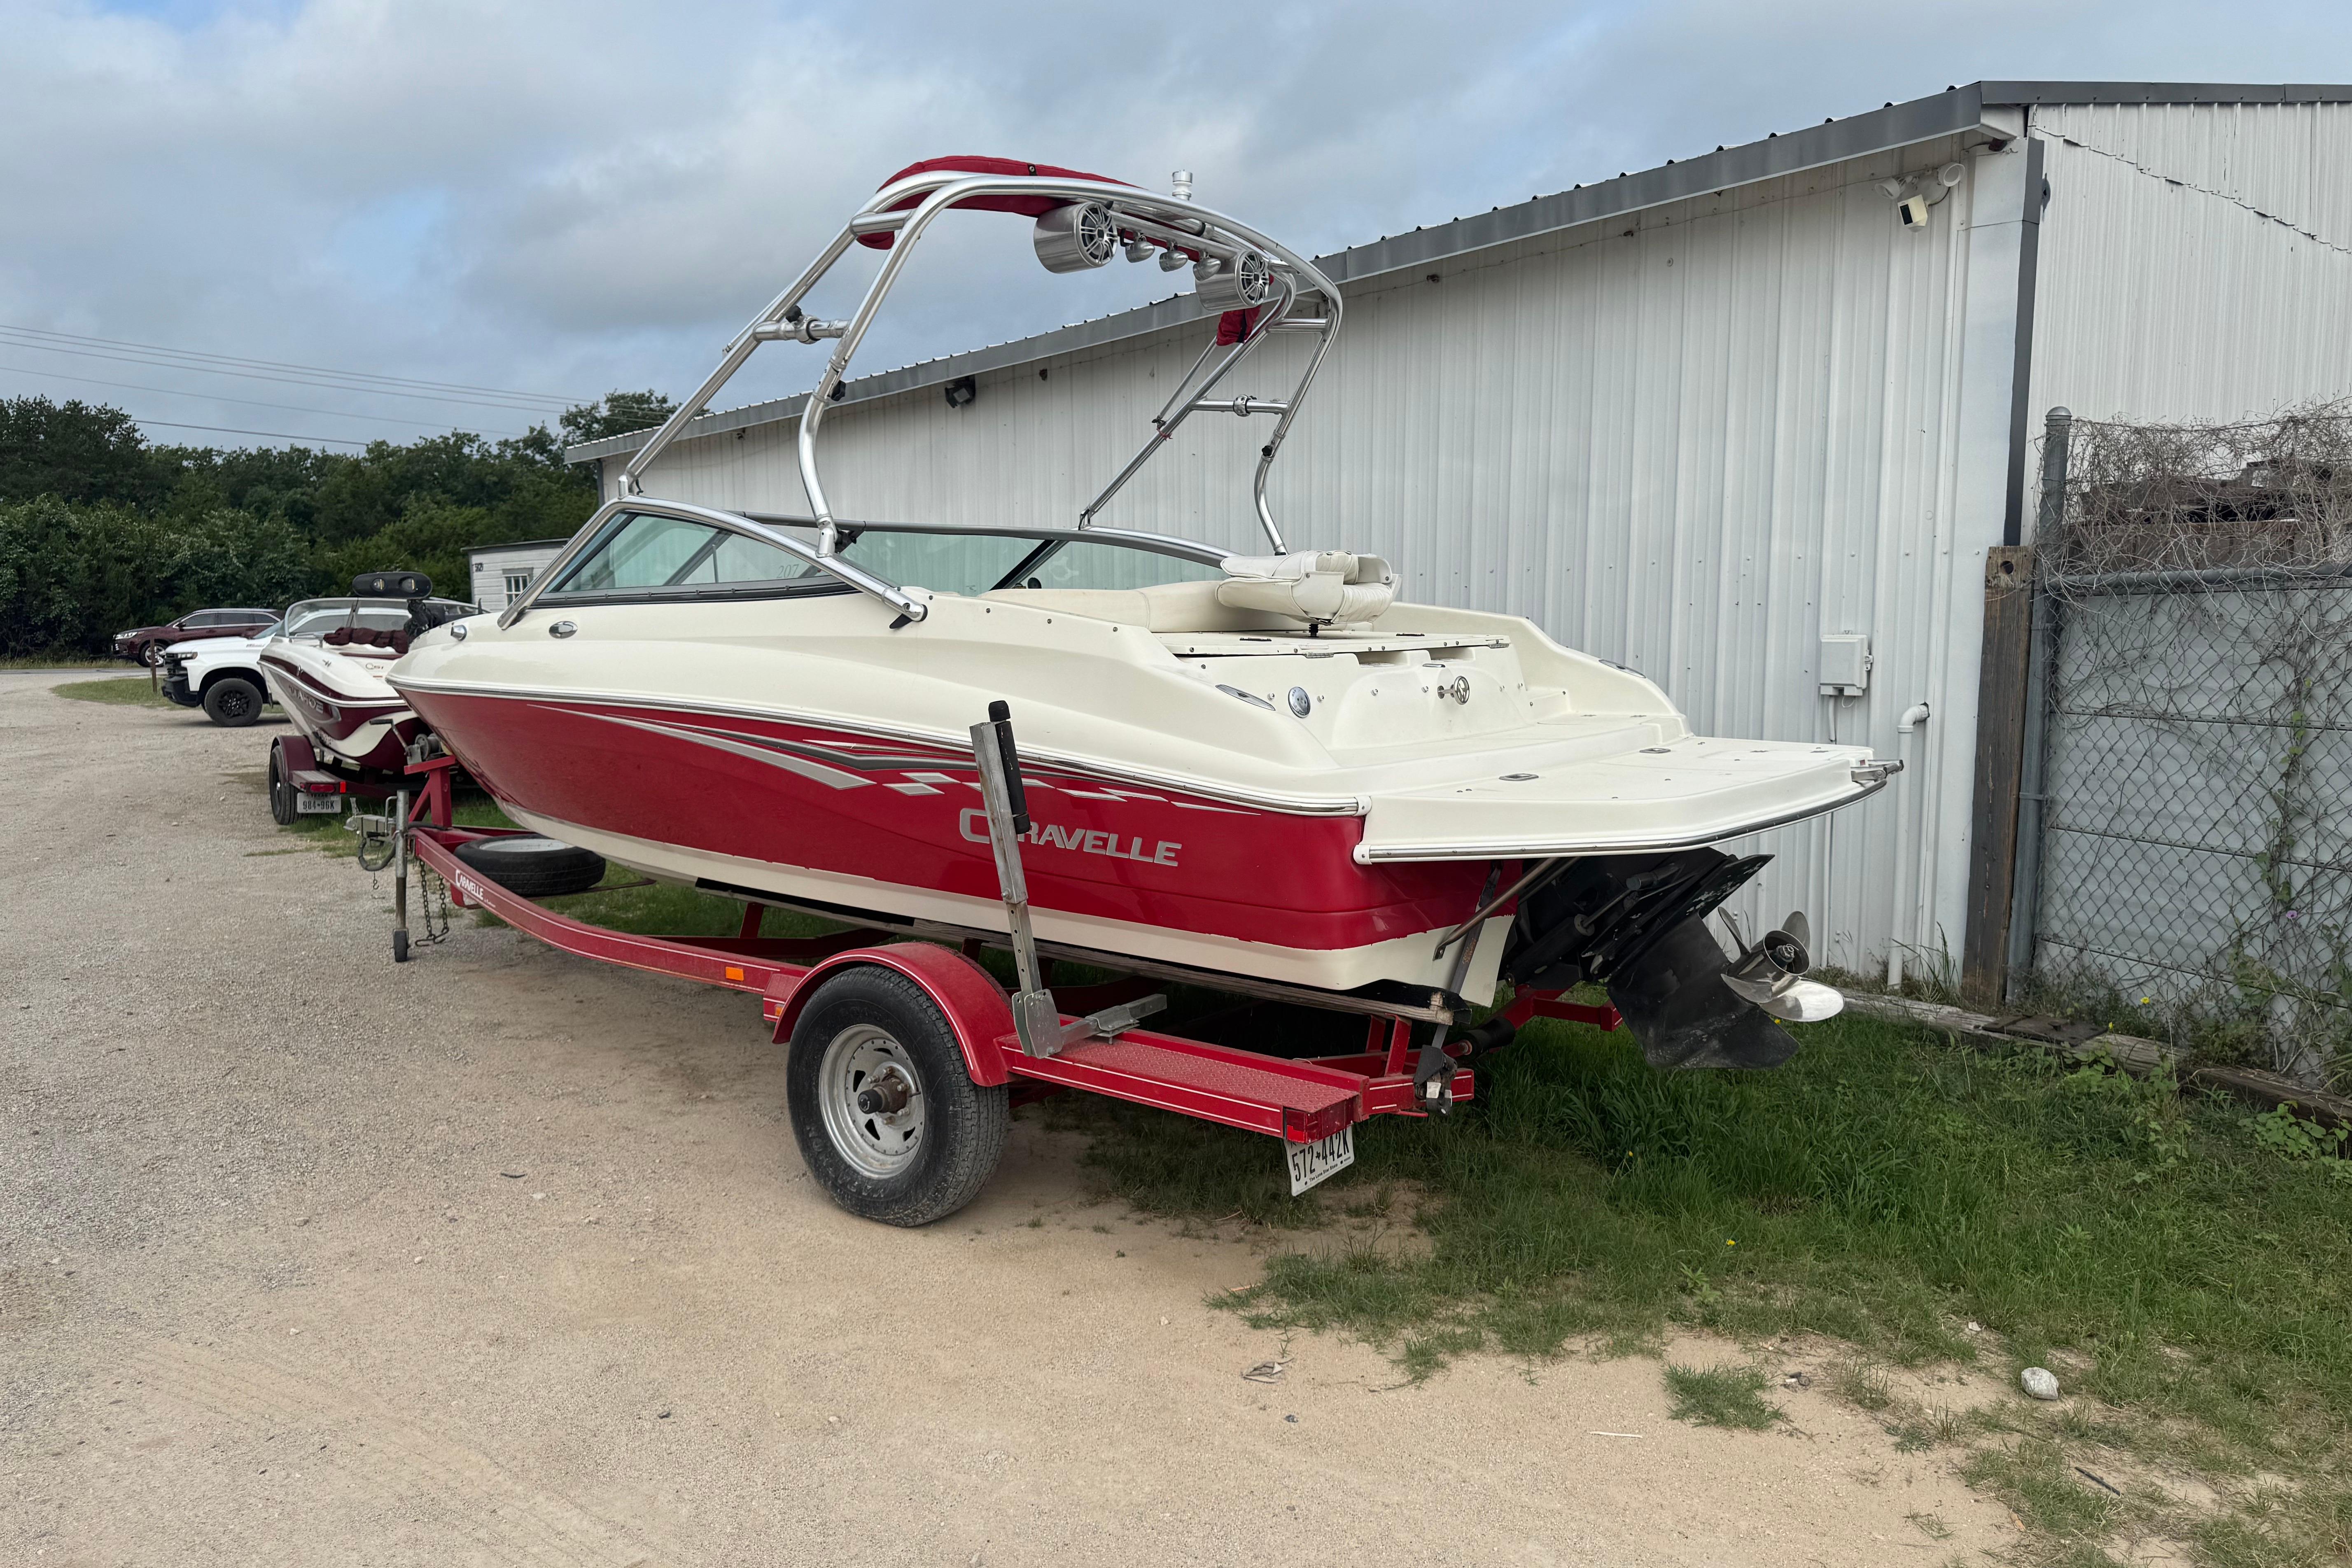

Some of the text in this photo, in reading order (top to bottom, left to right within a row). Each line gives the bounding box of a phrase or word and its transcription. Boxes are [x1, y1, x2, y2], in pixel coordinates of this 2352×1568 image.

[777, 564, 799, 578] 207
[959, 808, 1182, 866] CRAVELLE
[456, 869, 484, 901] CARAVELLE
[1292, 1127, 1349, 1182] 572 442K
